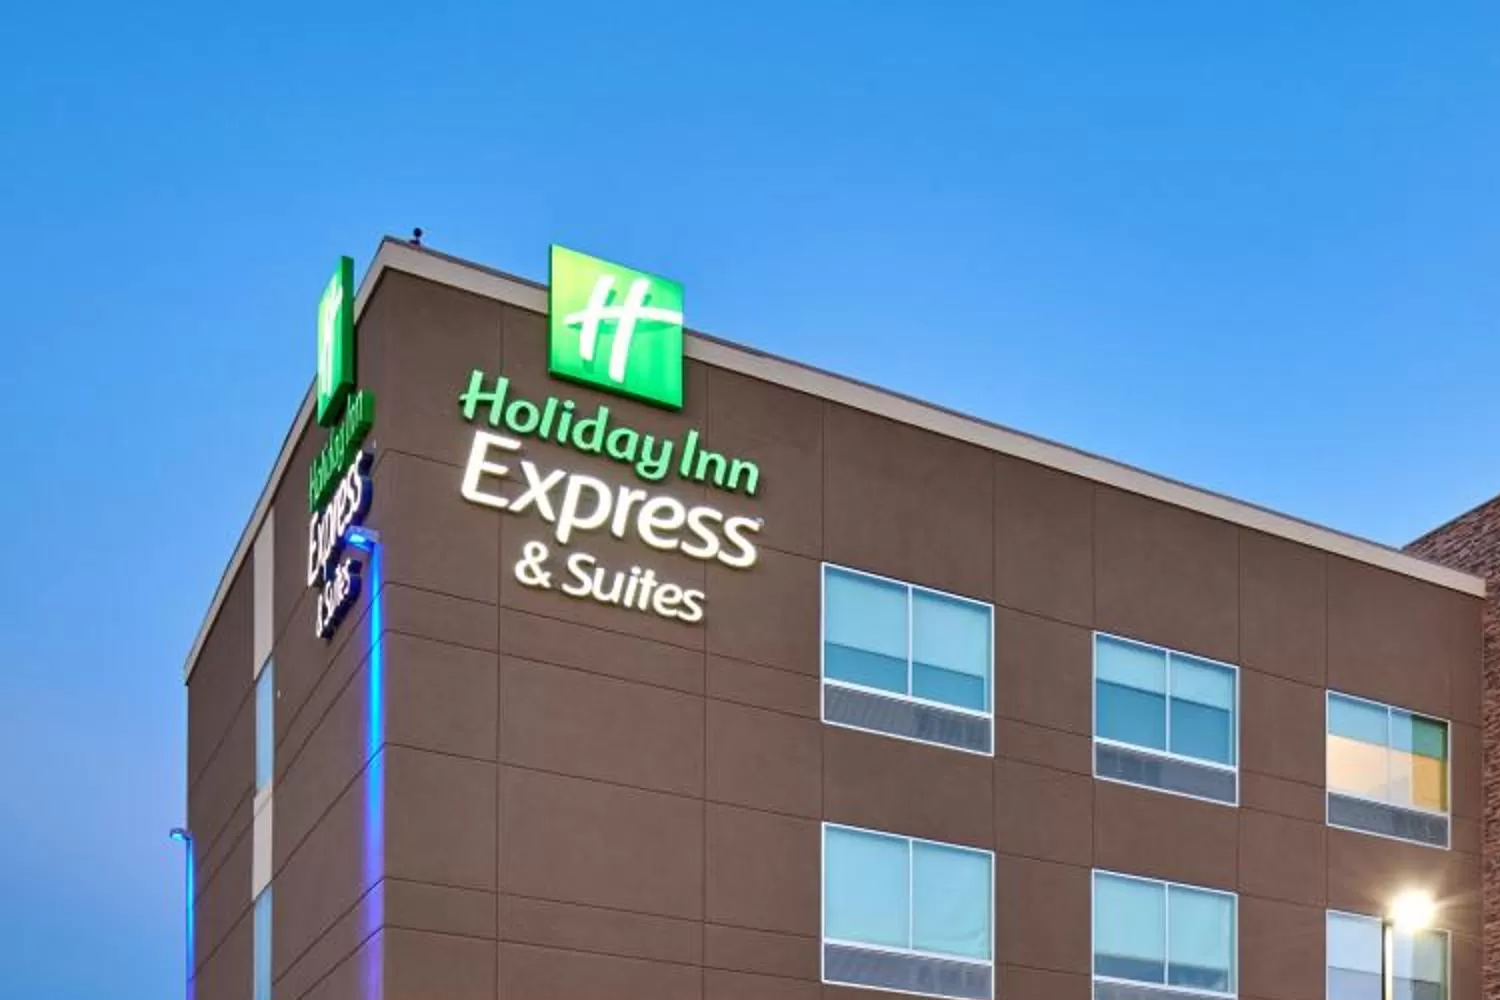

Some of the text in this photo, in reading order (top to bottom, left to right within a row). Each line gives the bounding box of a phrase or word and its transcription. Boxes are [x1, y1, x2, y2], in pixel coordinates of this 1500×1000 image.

[459, 369, 760, 495] Holiday Inn
[308, 450, 363, 586] Express
[460, 430, 761, 568] Express
[514, 540, 706, 623] & Suites
